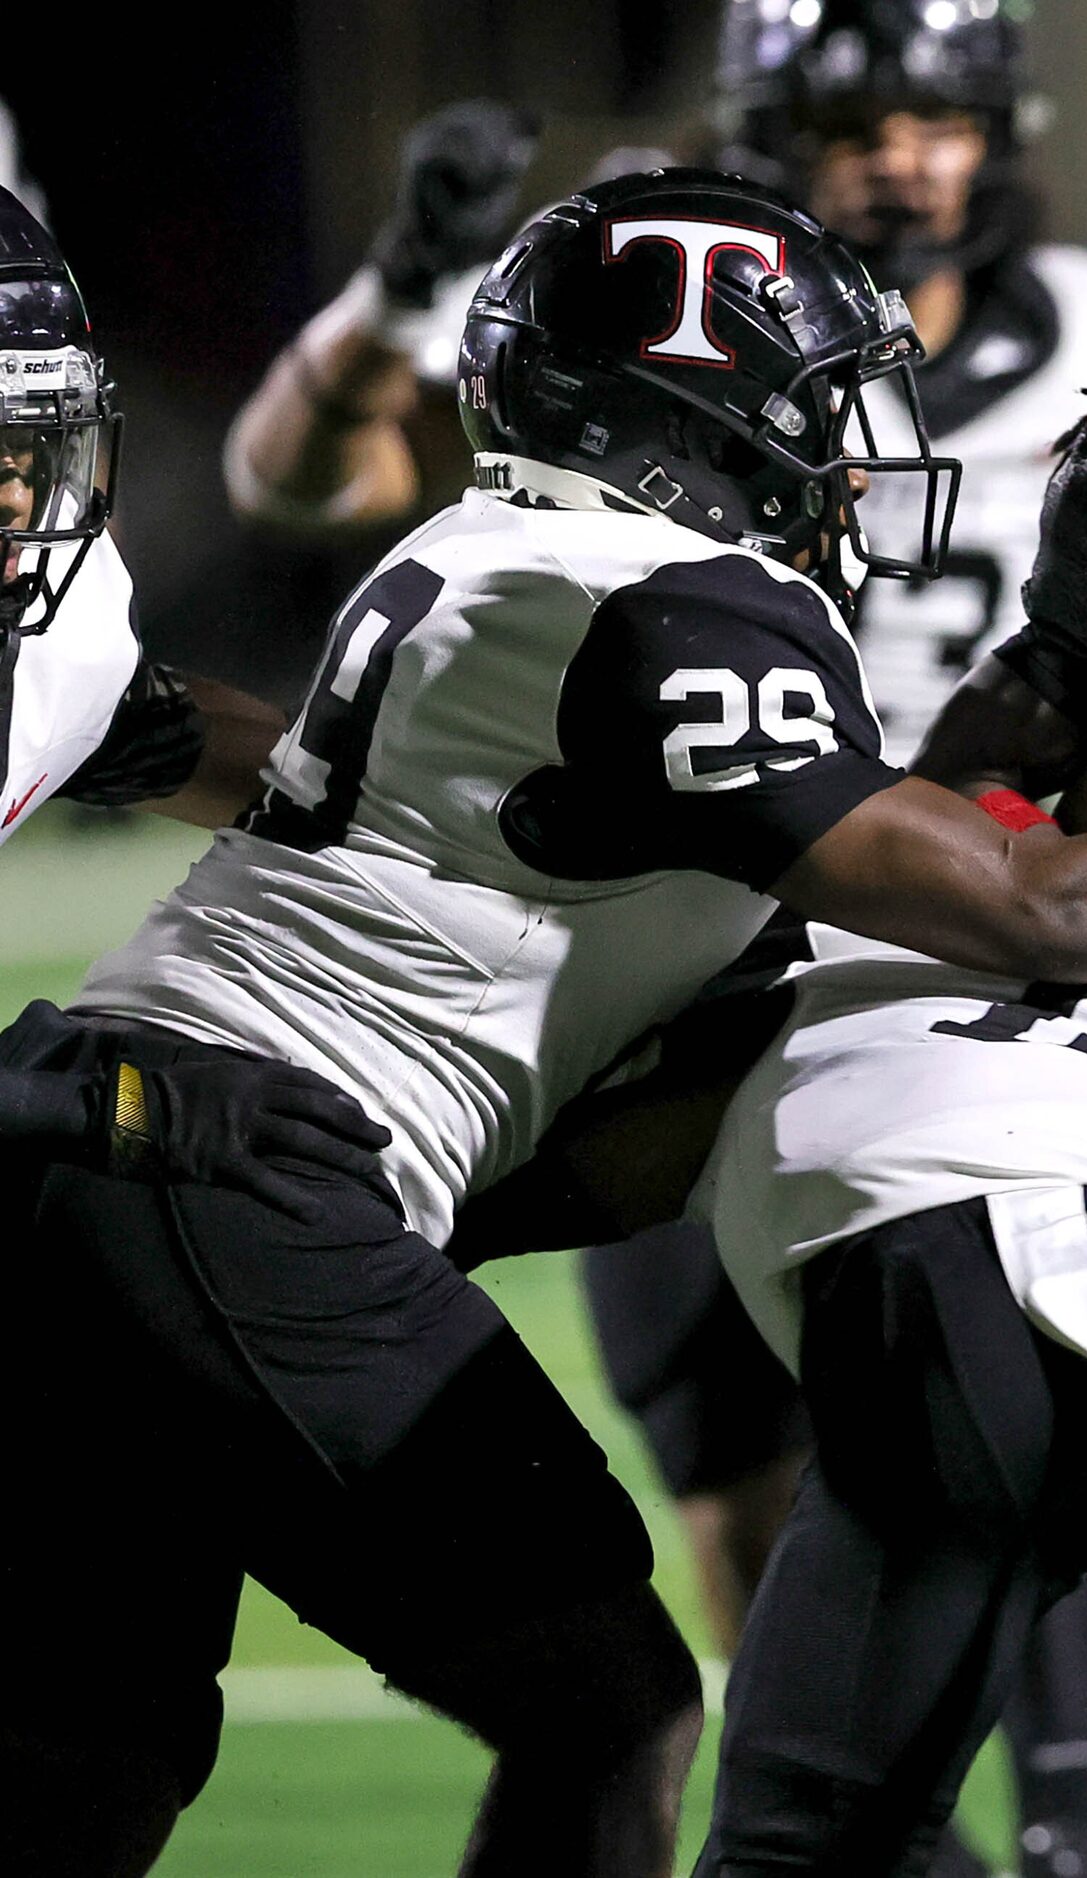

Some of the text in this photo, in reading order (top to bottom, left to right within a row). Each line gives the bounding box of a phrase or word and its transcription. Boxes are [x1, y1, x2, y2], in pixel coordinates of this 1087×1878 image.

[602, 214, 787, 370] T
[470, 375, 487, 410] 29
[659, 666, 840, 792] 29
